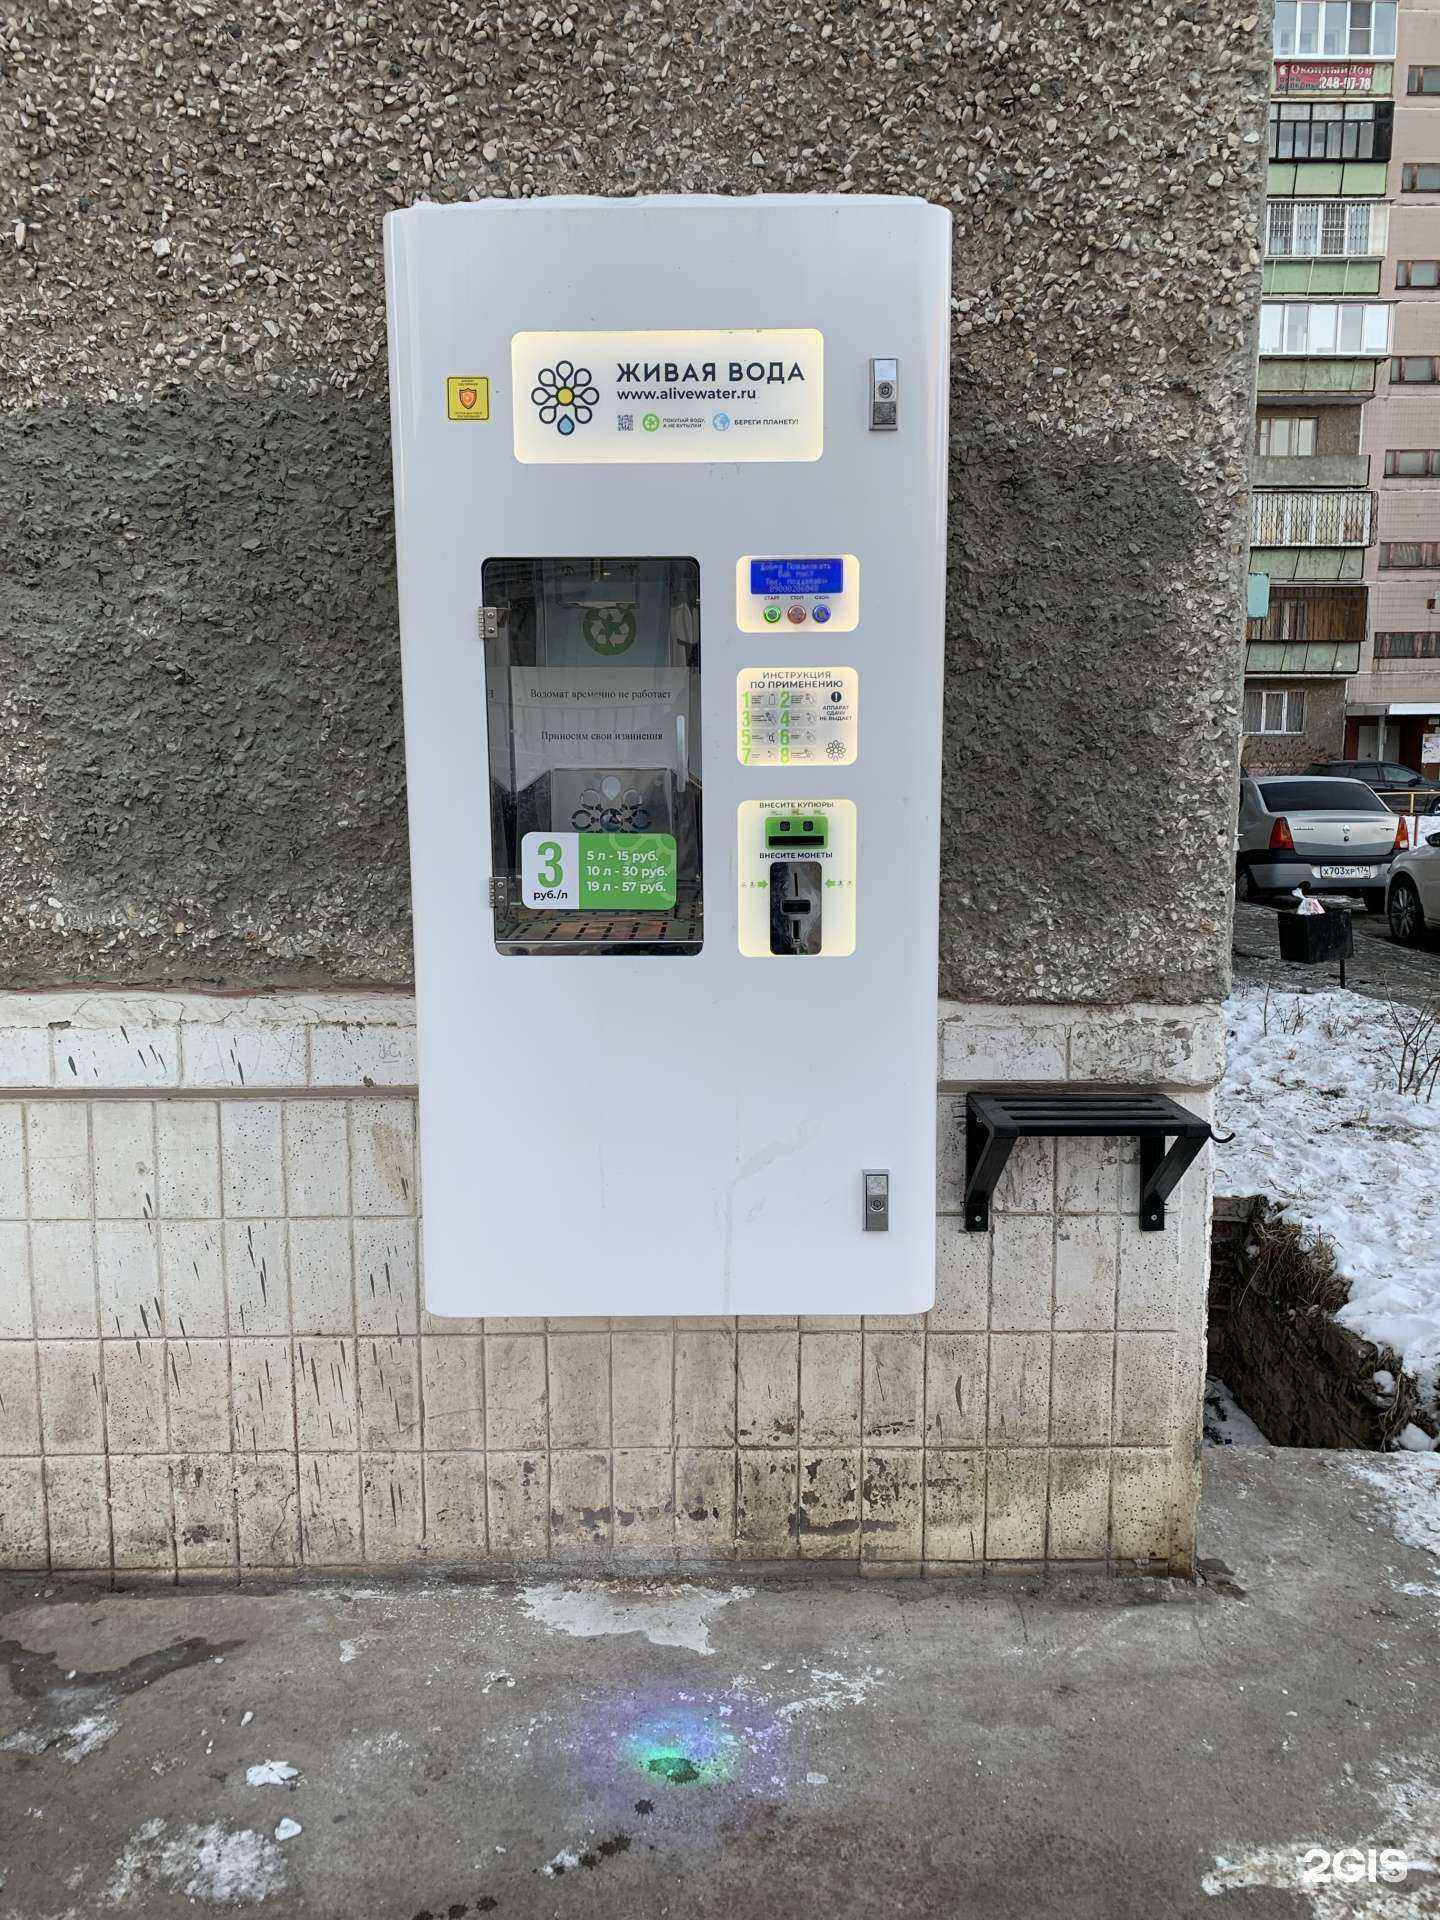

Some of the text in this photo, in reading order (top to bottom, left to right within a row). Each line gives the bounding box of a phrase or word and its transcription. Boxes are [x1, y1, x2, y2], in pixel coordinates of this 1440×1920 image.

[616, 361, 805, 385] ЖИВАЯ ВОДА
[617, 387, 756, 400] www.alivewater.ru
[763, 418, 799, 426] ПЛАНЕТУ!
[763, 671, 831, 680] ИНСТРУКЦИЯ
[750, 680, 844, 689] ПО ПРИМЕНЕНИЮ
[530, 688, 568, 699] Водомат
[618, 690, 629, 698] не
[632, 688, 671, 700] работает
[742, 691, 750, 708] 1
[781, 691, 790, 708] 2
[742, 710, 750, 726] 3
[781, 710, 790, 727] 4
[541, 731, 664, 743] Приносим свои извинения
[742, 729, 751, 745] 5
[742, 748, 751, 764] 7
[586, 851, 595, 861] 5
[597, 852, 606, 861] л
[617, 851, 629, 861] 15
[632, 850, 659, 864] руб.
[537, 841, 564, 888] 3
[586, 866, 600, 876] 10
[603, 867, 612, 877] л
[622, 866, 638, 877] 30
[641, 866, 668, 879] руб.
[586, 881, 600, 892] 19
[602, 883, 611, 892] л
[622, 881, 637, 892] 57
[640, 881, 667, 894] руб.
[533, 889, 568, 901] руб./л
